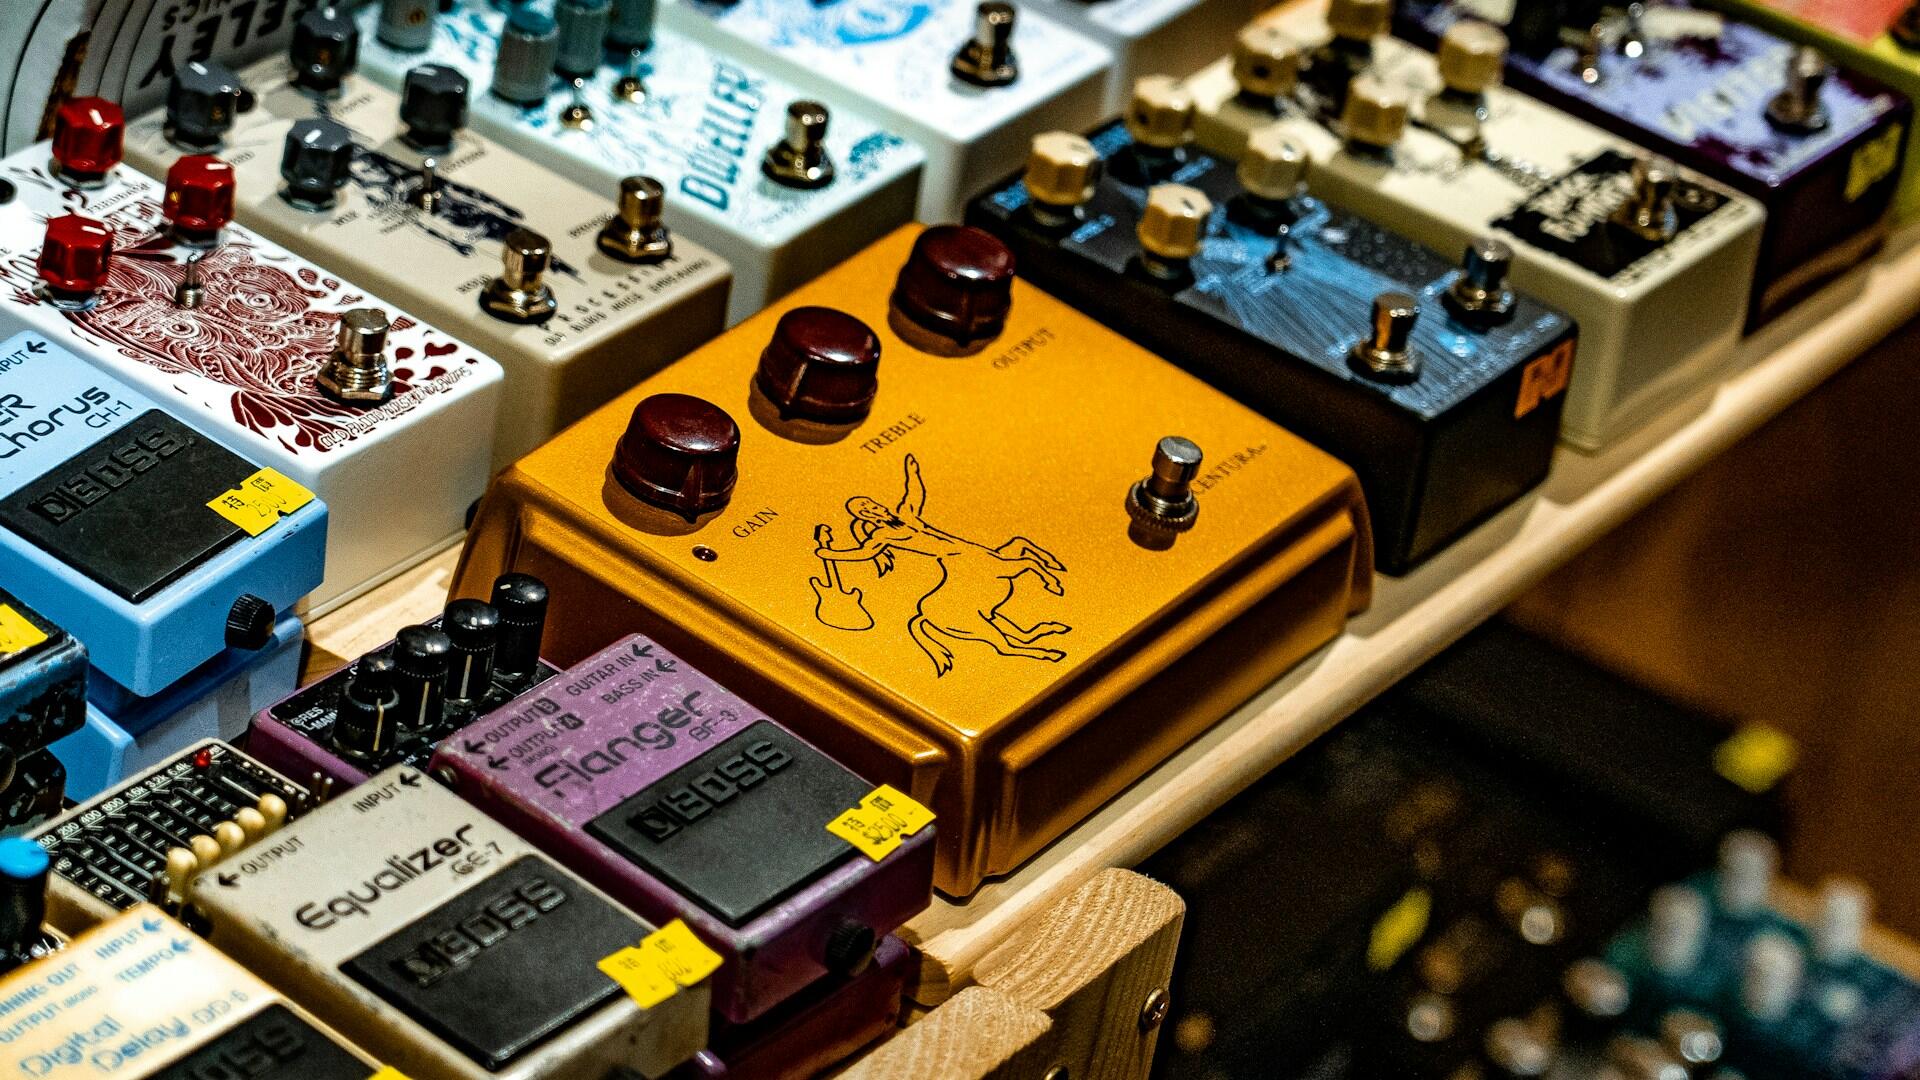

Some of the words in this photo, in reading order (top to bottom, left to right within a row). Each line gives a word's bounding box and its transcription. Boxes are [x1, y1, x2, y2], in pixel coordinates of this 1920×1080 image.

[991, 327, 1055, 370] OUTPUT
[84, 399, 132, 429] CH-1
[859, 411, 926, 455] TREBLE
[33, 428, 188, 522] BOSS
[732, 506, 780, 539] GAIN
[565, 662, 624, 697] GUITAR
[615, 651, 639, 673] IN
[601, 678, 644, 706] BASS
[640, 667, 660, 685] IN
[484, 706, 538, 744] OUTPUT
[507, 724, 566, 759] OUTPUT
[533, 690, 702, 799] Flanger
[688, 709, 739, 743] BF-3
[57, 821, 79, 836] 200
[79, 809, 102, 825] 400
[102, 796, 125, 812] 800
[145, 773, 169, 789] 3.2k
[167, 762, 192, 777] 6.4k
[353, 781, 402, 814] INPUT
[634, 740, 794, 838] BOSS
[241, 836, 304, 875] OUTPUT
[451, 840, 501, 876] GE-7
[296, 823, 474, 931] Equalizer
[94, 927, 144, 960] INPUT
[396, 876, 568, 988] BOSS
[47, 962, 82, 987] OUT
[116, 948, 175, 982] TEMPO
[19, 1014, 123, 1078] Digital
[91, 1016, 191, 1072] Delay
